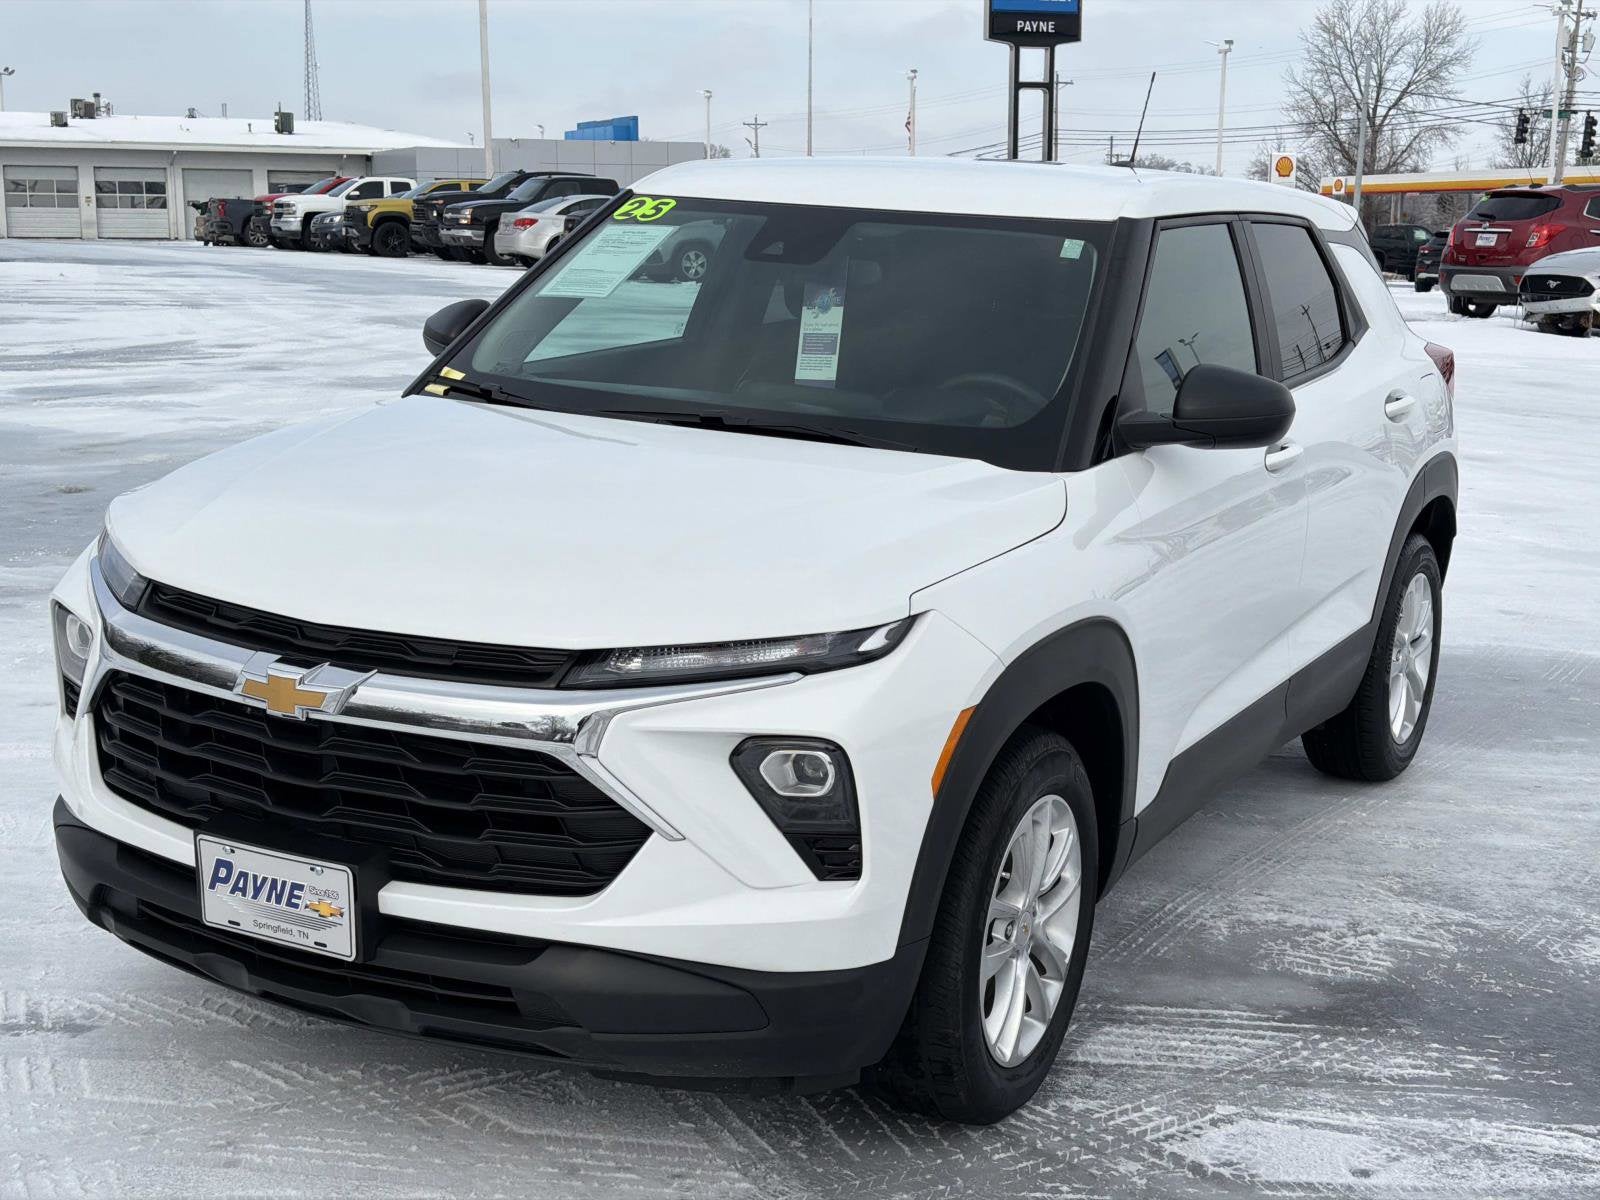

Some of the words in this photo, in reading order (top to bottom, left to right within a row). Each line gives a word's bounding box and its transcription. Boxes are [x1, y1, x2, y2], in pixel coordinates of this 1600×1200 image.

[1016, 20, 1056, 33] PAYNE
[614, 197, 676, 221] 25
[208, 857, 305, 910] PAYNE
[252, 919, 295, 938] Springfield,
[299, 929, 309, 940] TN
